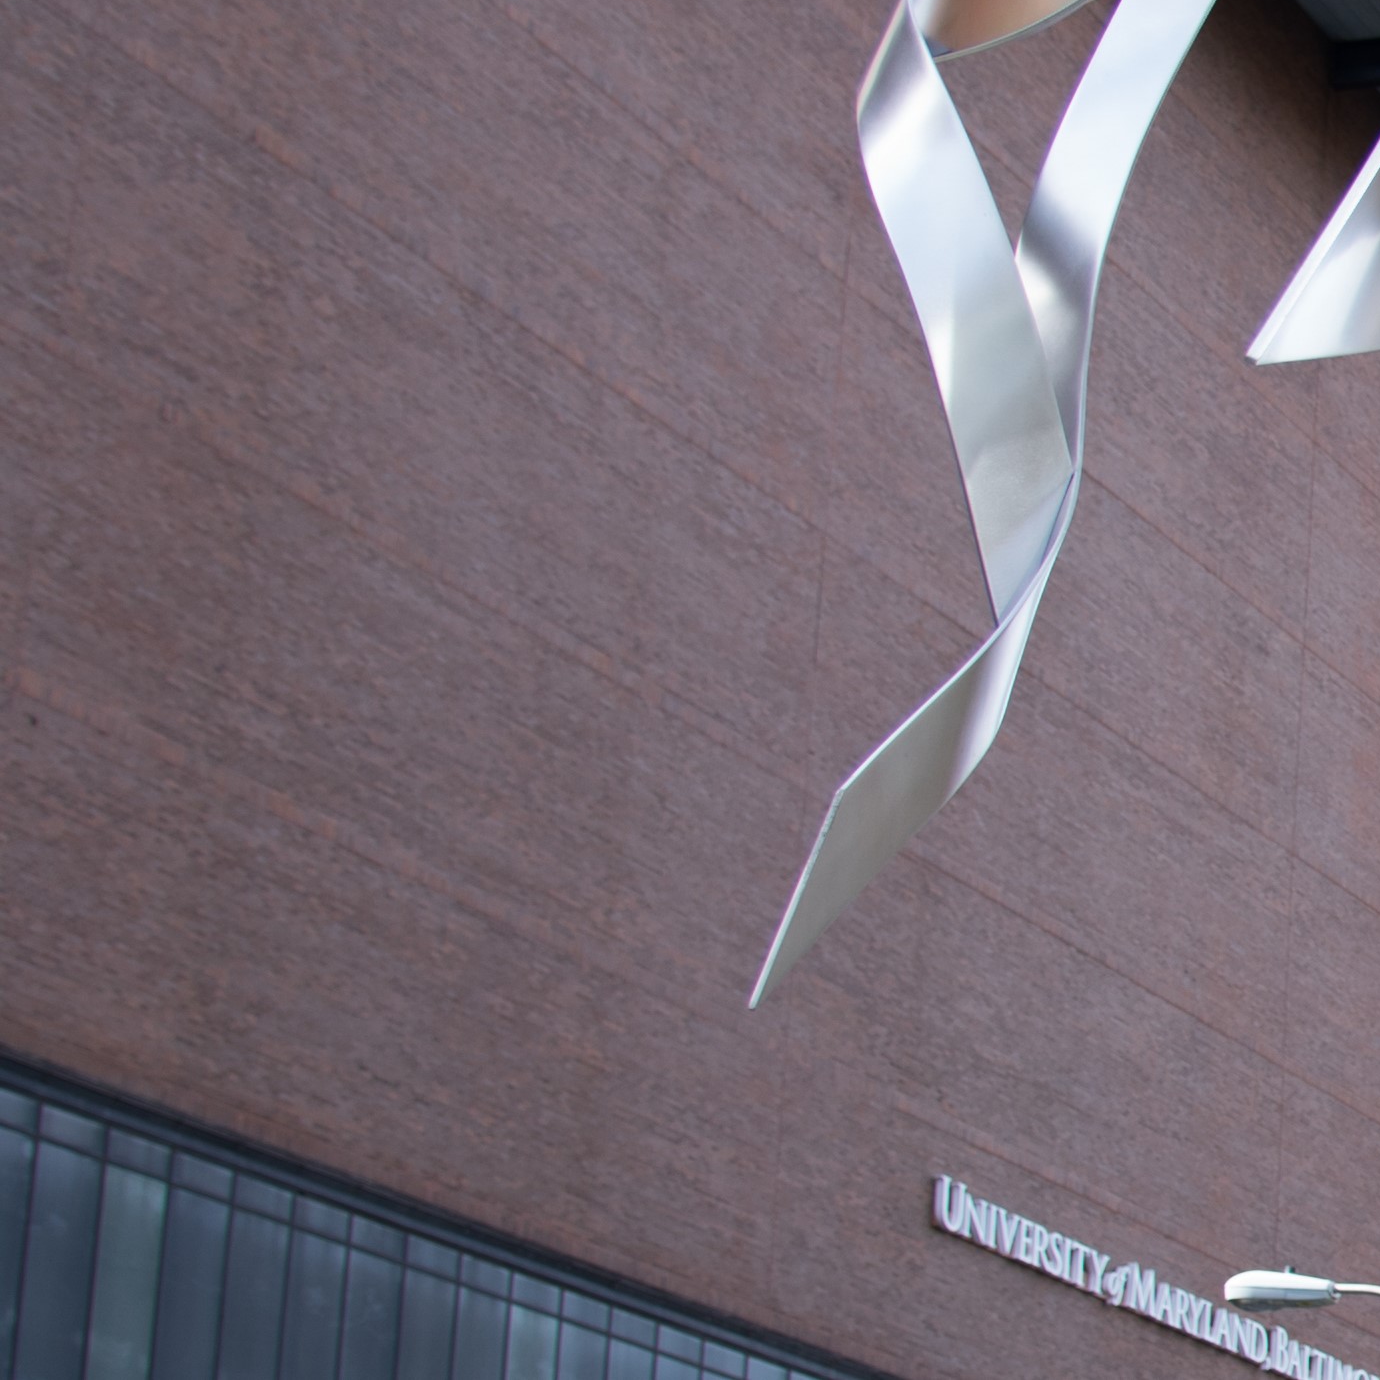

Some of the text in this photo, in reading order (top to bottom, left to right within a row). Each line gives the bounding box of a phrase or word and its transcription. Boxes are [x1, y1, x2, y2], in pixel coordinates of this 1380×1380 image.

[934, 1174, 1380, 1380] UNIVERSITY of MARYLAND, BALTIM
